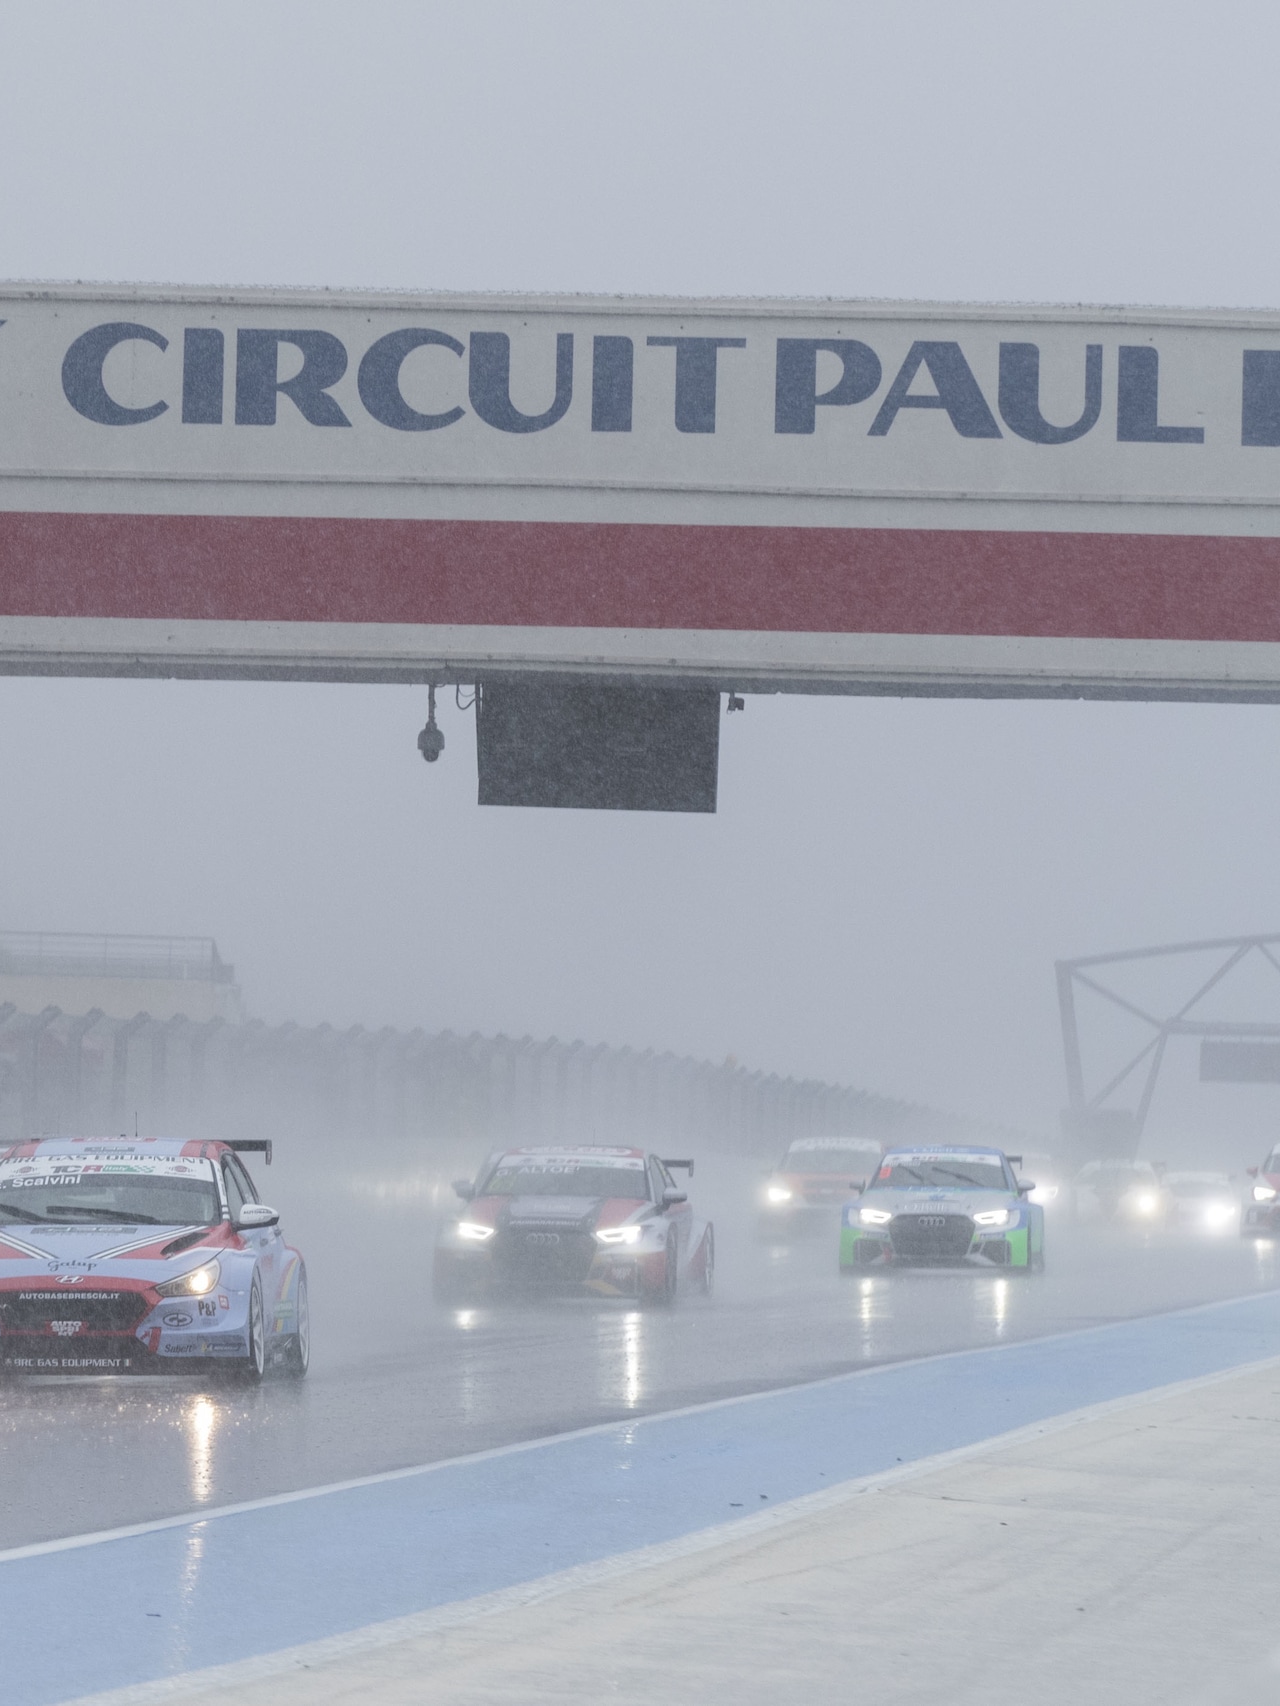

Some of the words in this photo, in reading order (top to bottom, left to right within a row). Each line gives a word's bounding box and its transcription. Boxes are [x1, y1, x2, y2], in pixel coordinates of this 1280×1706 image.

[60, 321, 746, 434] CIRCUIT
[773, 337, 1206, 445] PAUL
[51, 1164, 103, 1174] TCR
[11, 1175, 82, 1189] Scalvini
[19, 1292, 120, 1300] AUTOBASEBRESCIA.IT
[198, 1300, 217, 1317] P&P
[164, 1343, 193, 1354] Sabelt
[37, 1358, 59, 1367] GAS
[61, 1358, 122, 1367] EQUIPMENT
